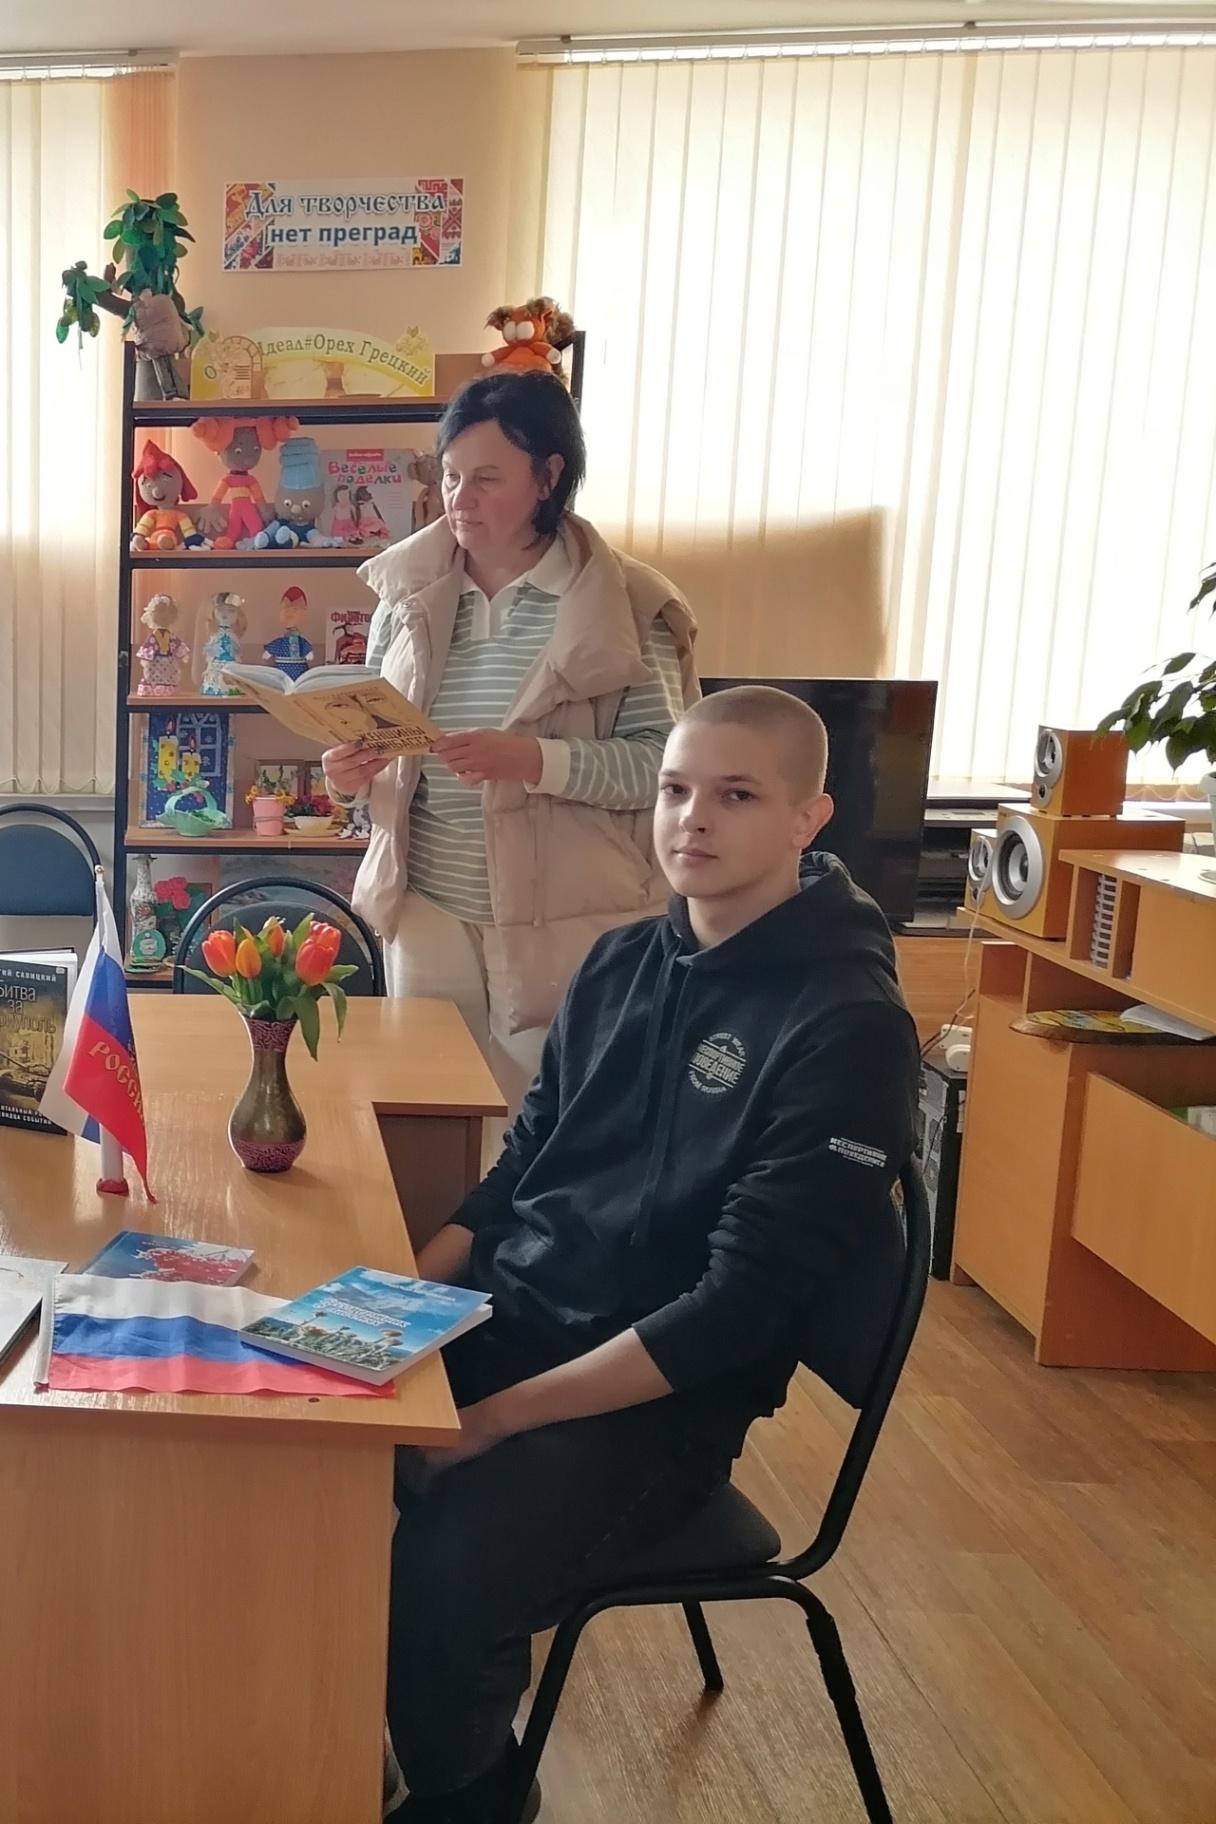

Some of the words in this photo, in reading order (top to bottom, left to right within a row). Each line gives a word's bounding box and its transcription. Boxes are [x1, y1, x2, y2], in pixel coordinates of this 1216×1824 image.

[245, 191, 292, 218] Для
[300, 193, 445, 219] творчества
[270, 227, 312, 243] нет
[319, 226, 418, 247] преград
[359, 339, 432, 385] Грецкий
[328, 461, 397, 474] Веселые
[337, 474, 402, 485] поделки
[7, 1000, 23, 1014] за
